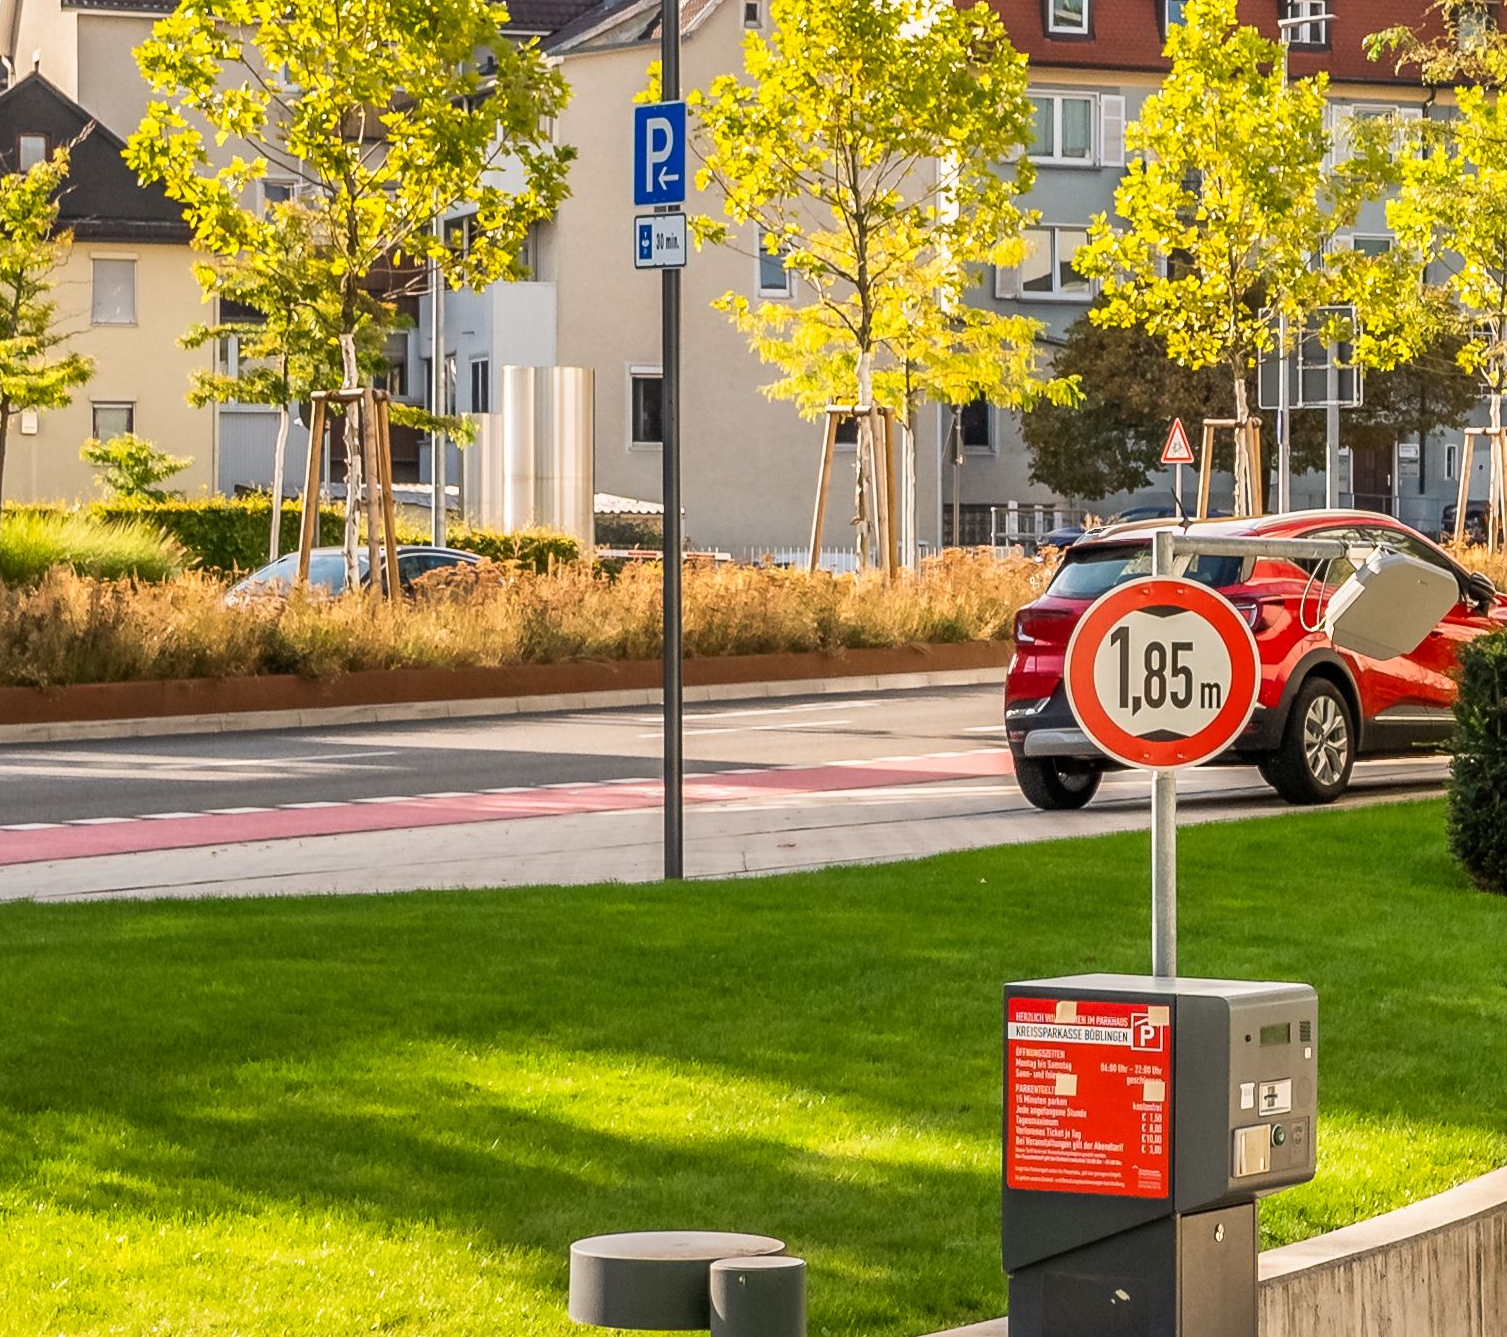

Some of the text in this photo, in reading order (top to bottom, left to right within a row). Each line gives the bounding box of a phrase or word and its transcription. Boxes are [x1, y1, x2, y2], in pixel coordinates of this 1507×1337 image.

[646, 117, 674, 193] P
[656, 232, 665, 251] 30
[1110, 626, 1222, 717] 1,85 m
[1016, 1025, 1128, 1043] KREISSPARKASSE BÖBLINGEN
[1140, 1025, 1155, 1047] P
